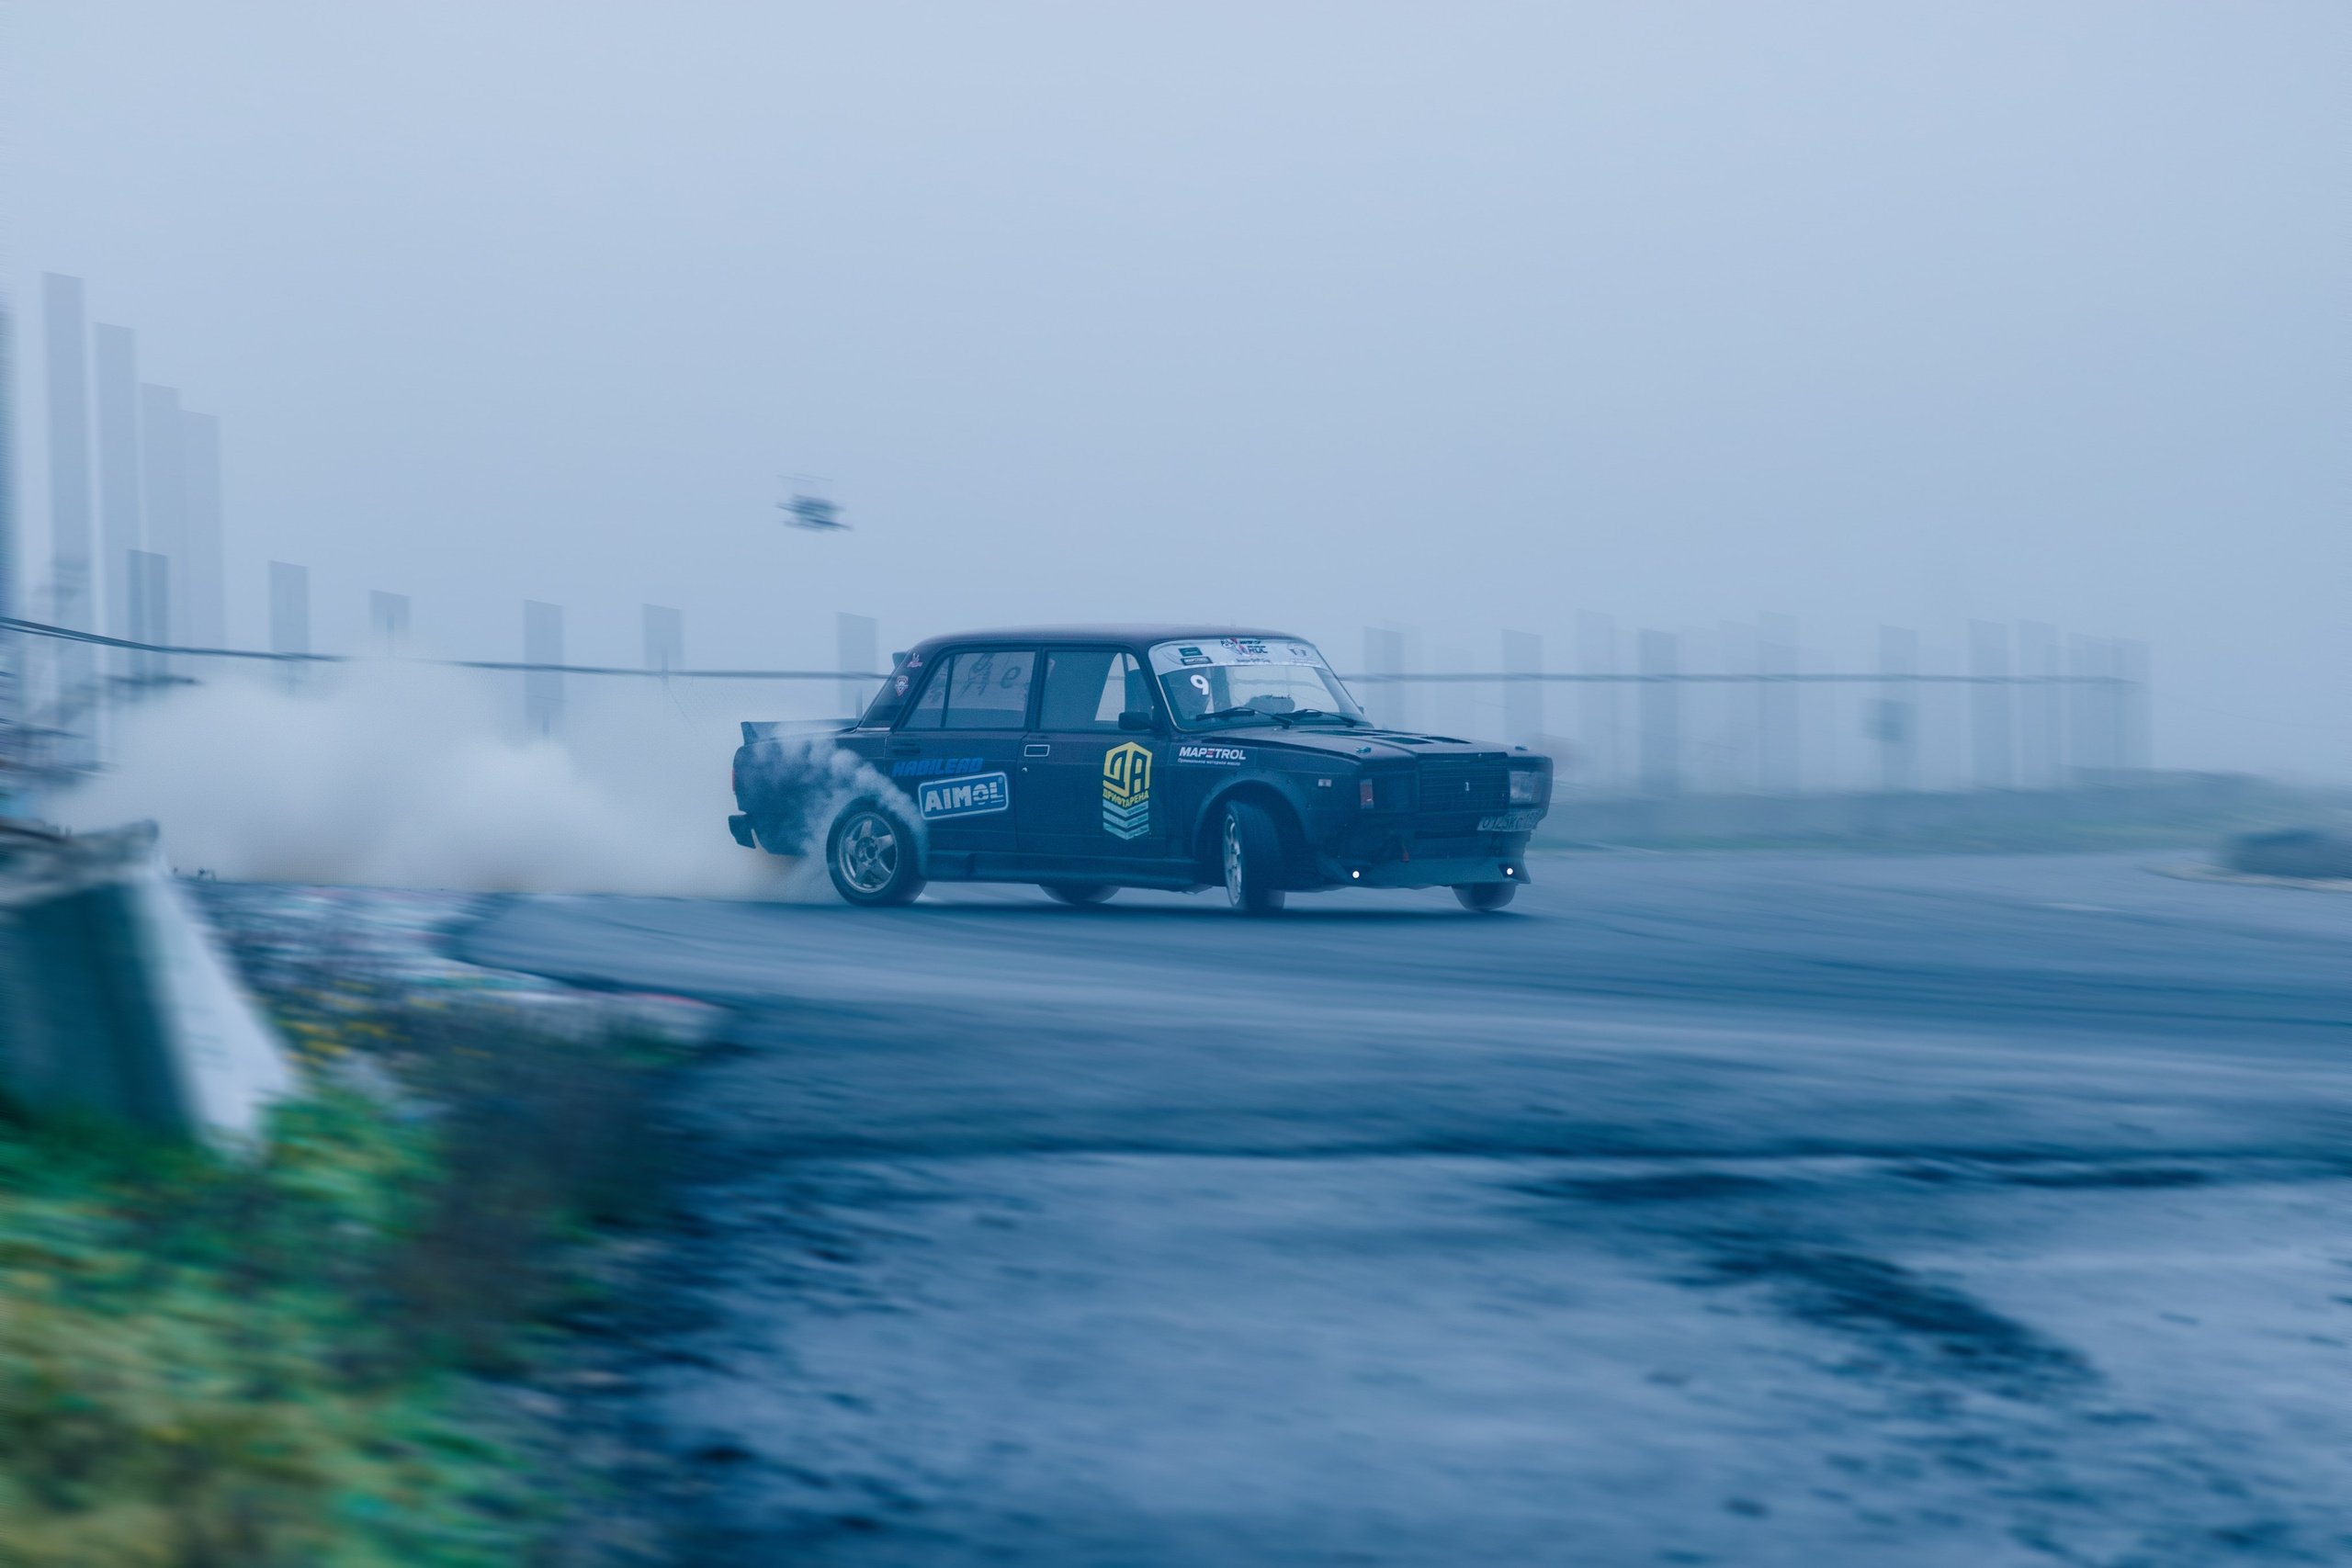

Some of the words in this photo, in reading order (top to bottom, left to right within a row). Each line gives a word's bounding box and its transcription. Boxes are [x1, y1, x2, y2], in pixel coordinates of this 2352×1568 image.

[1190, 674, 1210, 695] 9
[1179, 747, 1247, 761] MAPETROL
[924, 782, 1004, 812] AIMOL
[1102, 788, 1149, 808] ДРИФТАРЕНА
